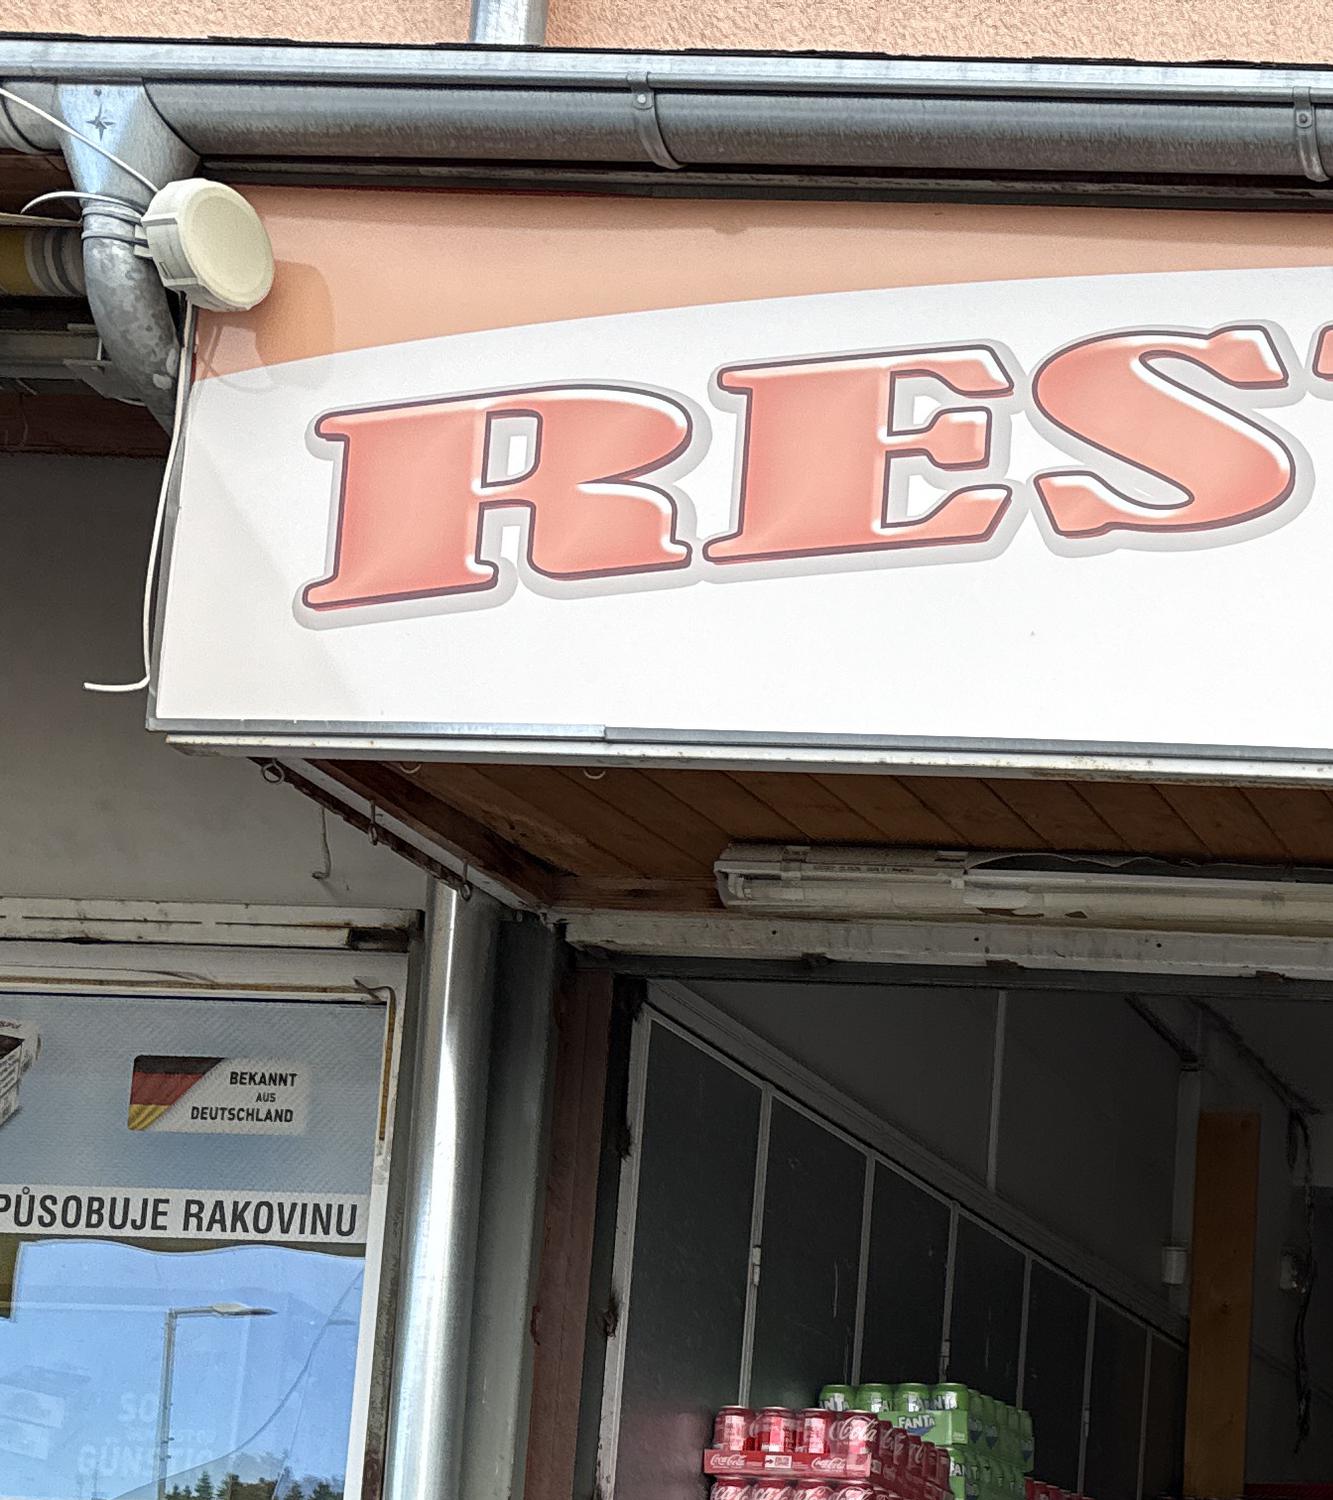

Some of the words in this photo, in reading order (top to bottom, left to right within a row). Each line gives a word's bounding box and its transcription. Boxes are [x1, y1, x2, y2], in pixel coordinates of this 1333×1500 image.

[230, 1071, 297, 1087] BEKANNT
[256, 1092, 276, 1103] AUS
[191, 1107, 293, 1123] DEUTSCHLAND
[182, 1200, 358, 1237] RAKOVINU
[897, 1415, 936, 1429] FANTA
